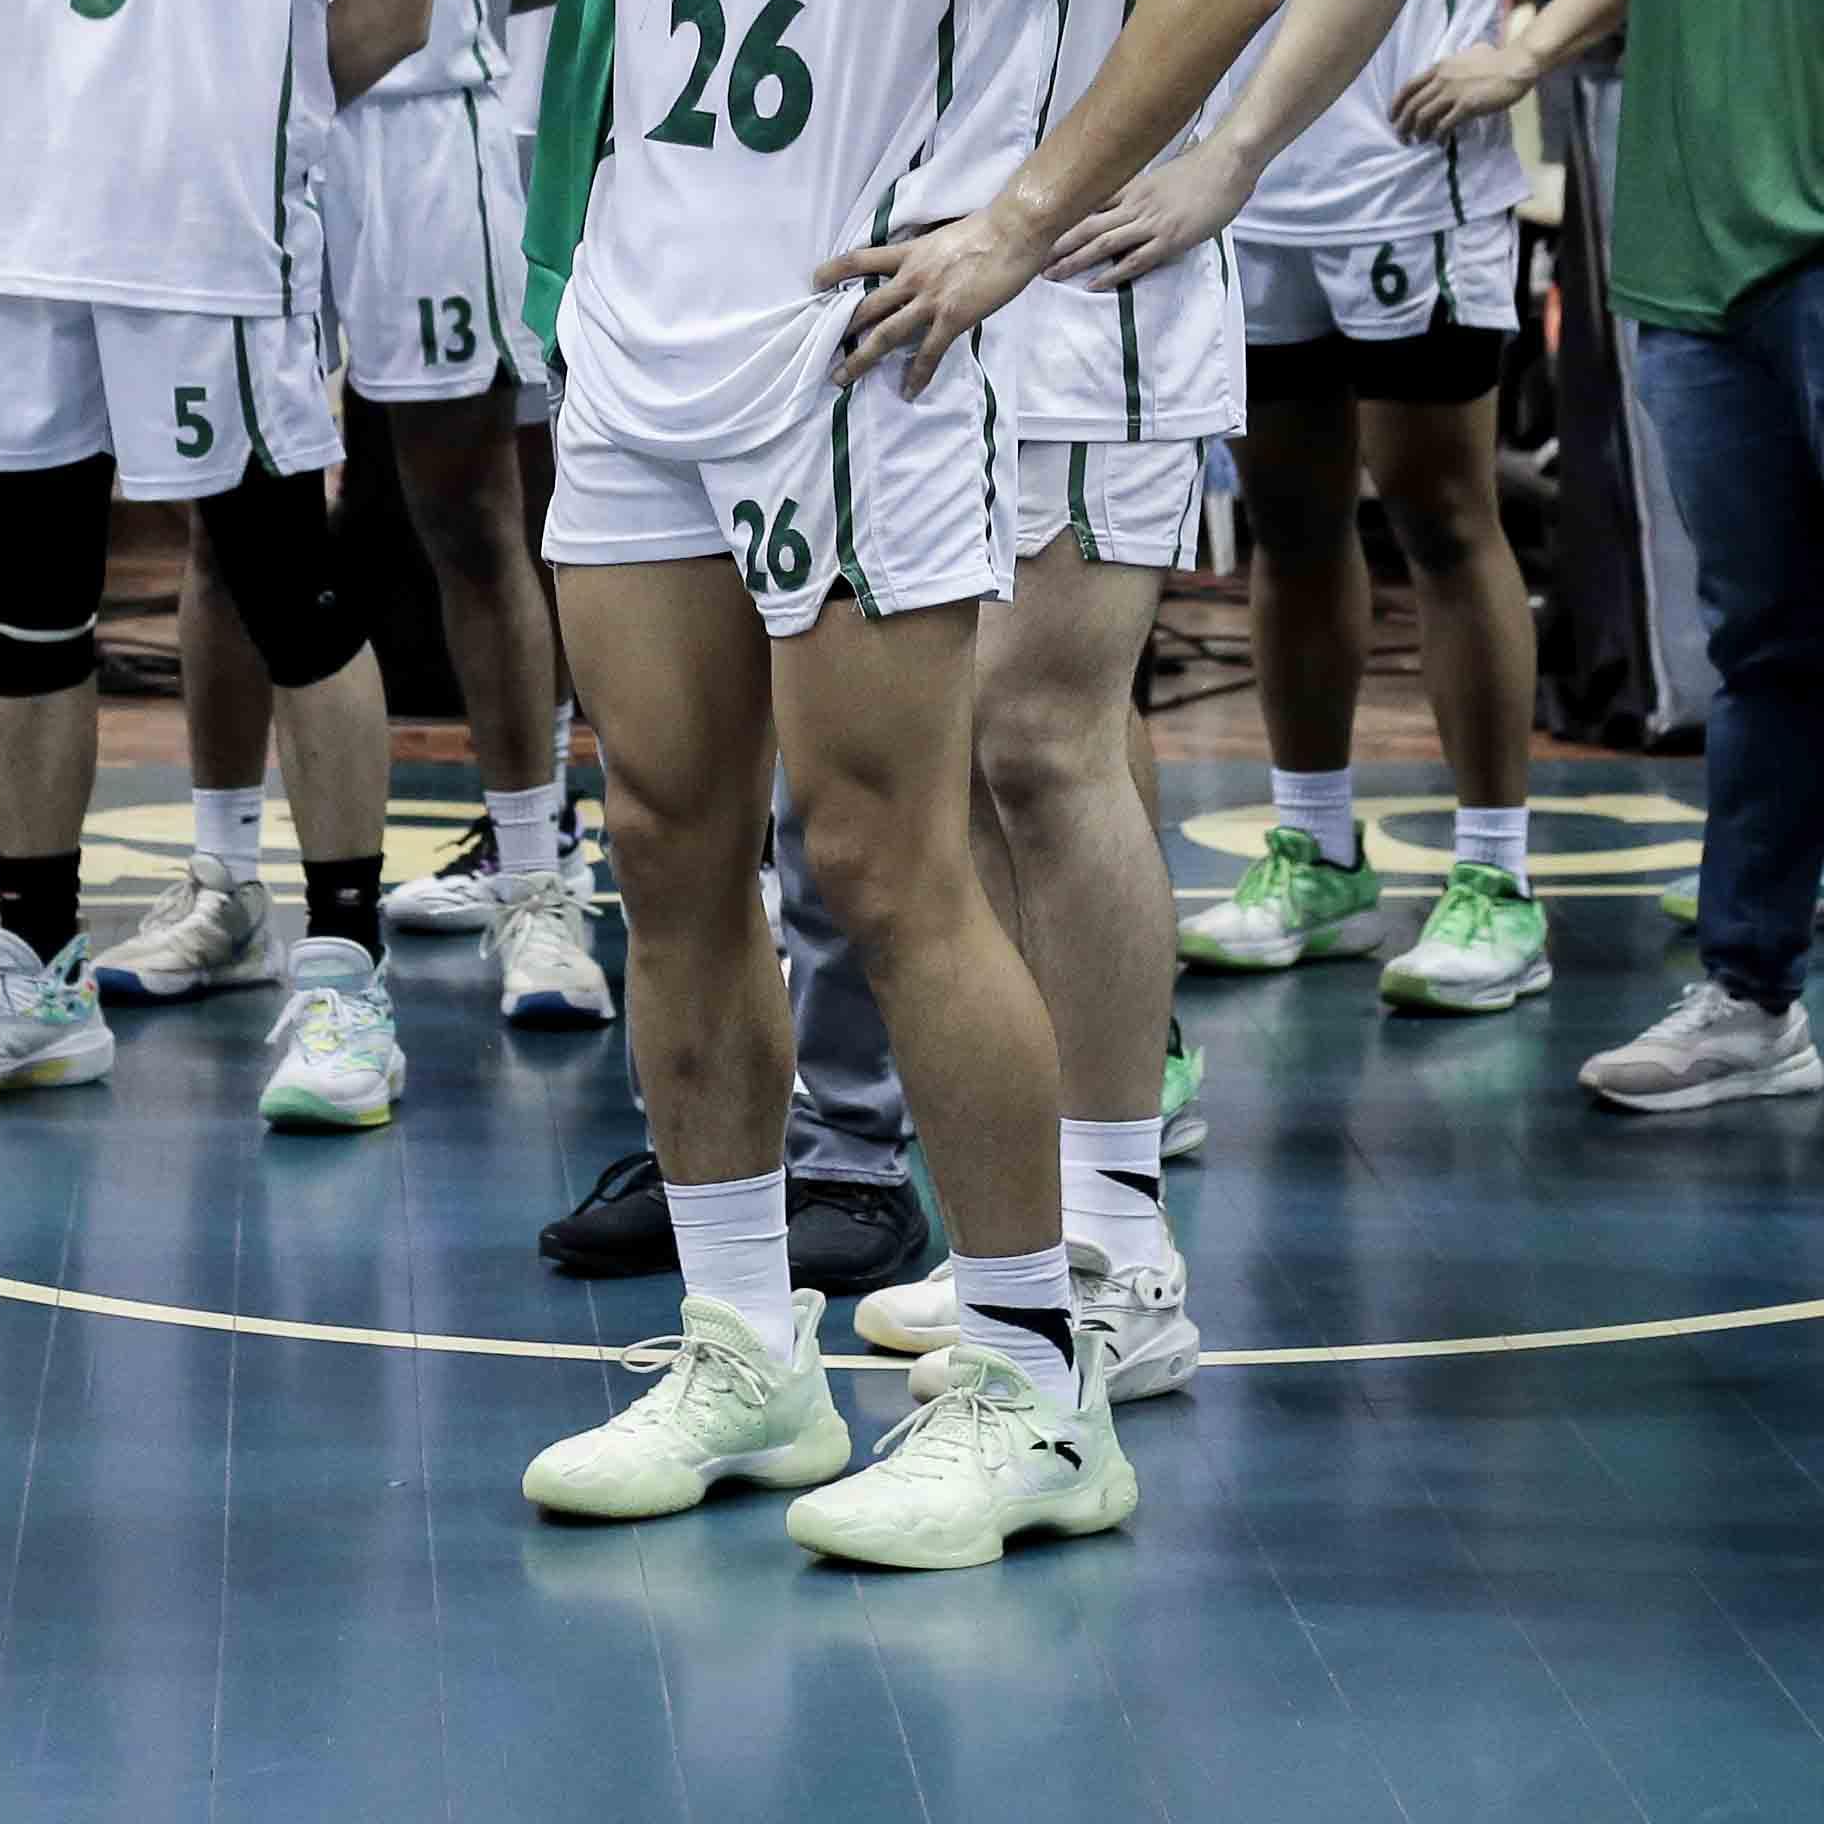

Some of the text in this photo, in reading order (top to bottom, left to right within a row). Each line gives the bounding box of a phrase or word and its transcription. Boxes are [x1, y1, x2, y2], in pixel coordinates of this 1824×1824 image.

[1370, 244, 1409, 307] 6
[418, 295, 477, 367] 13
[173, 386, 215, 459] 5
[732, 497, 813, 593] 26
